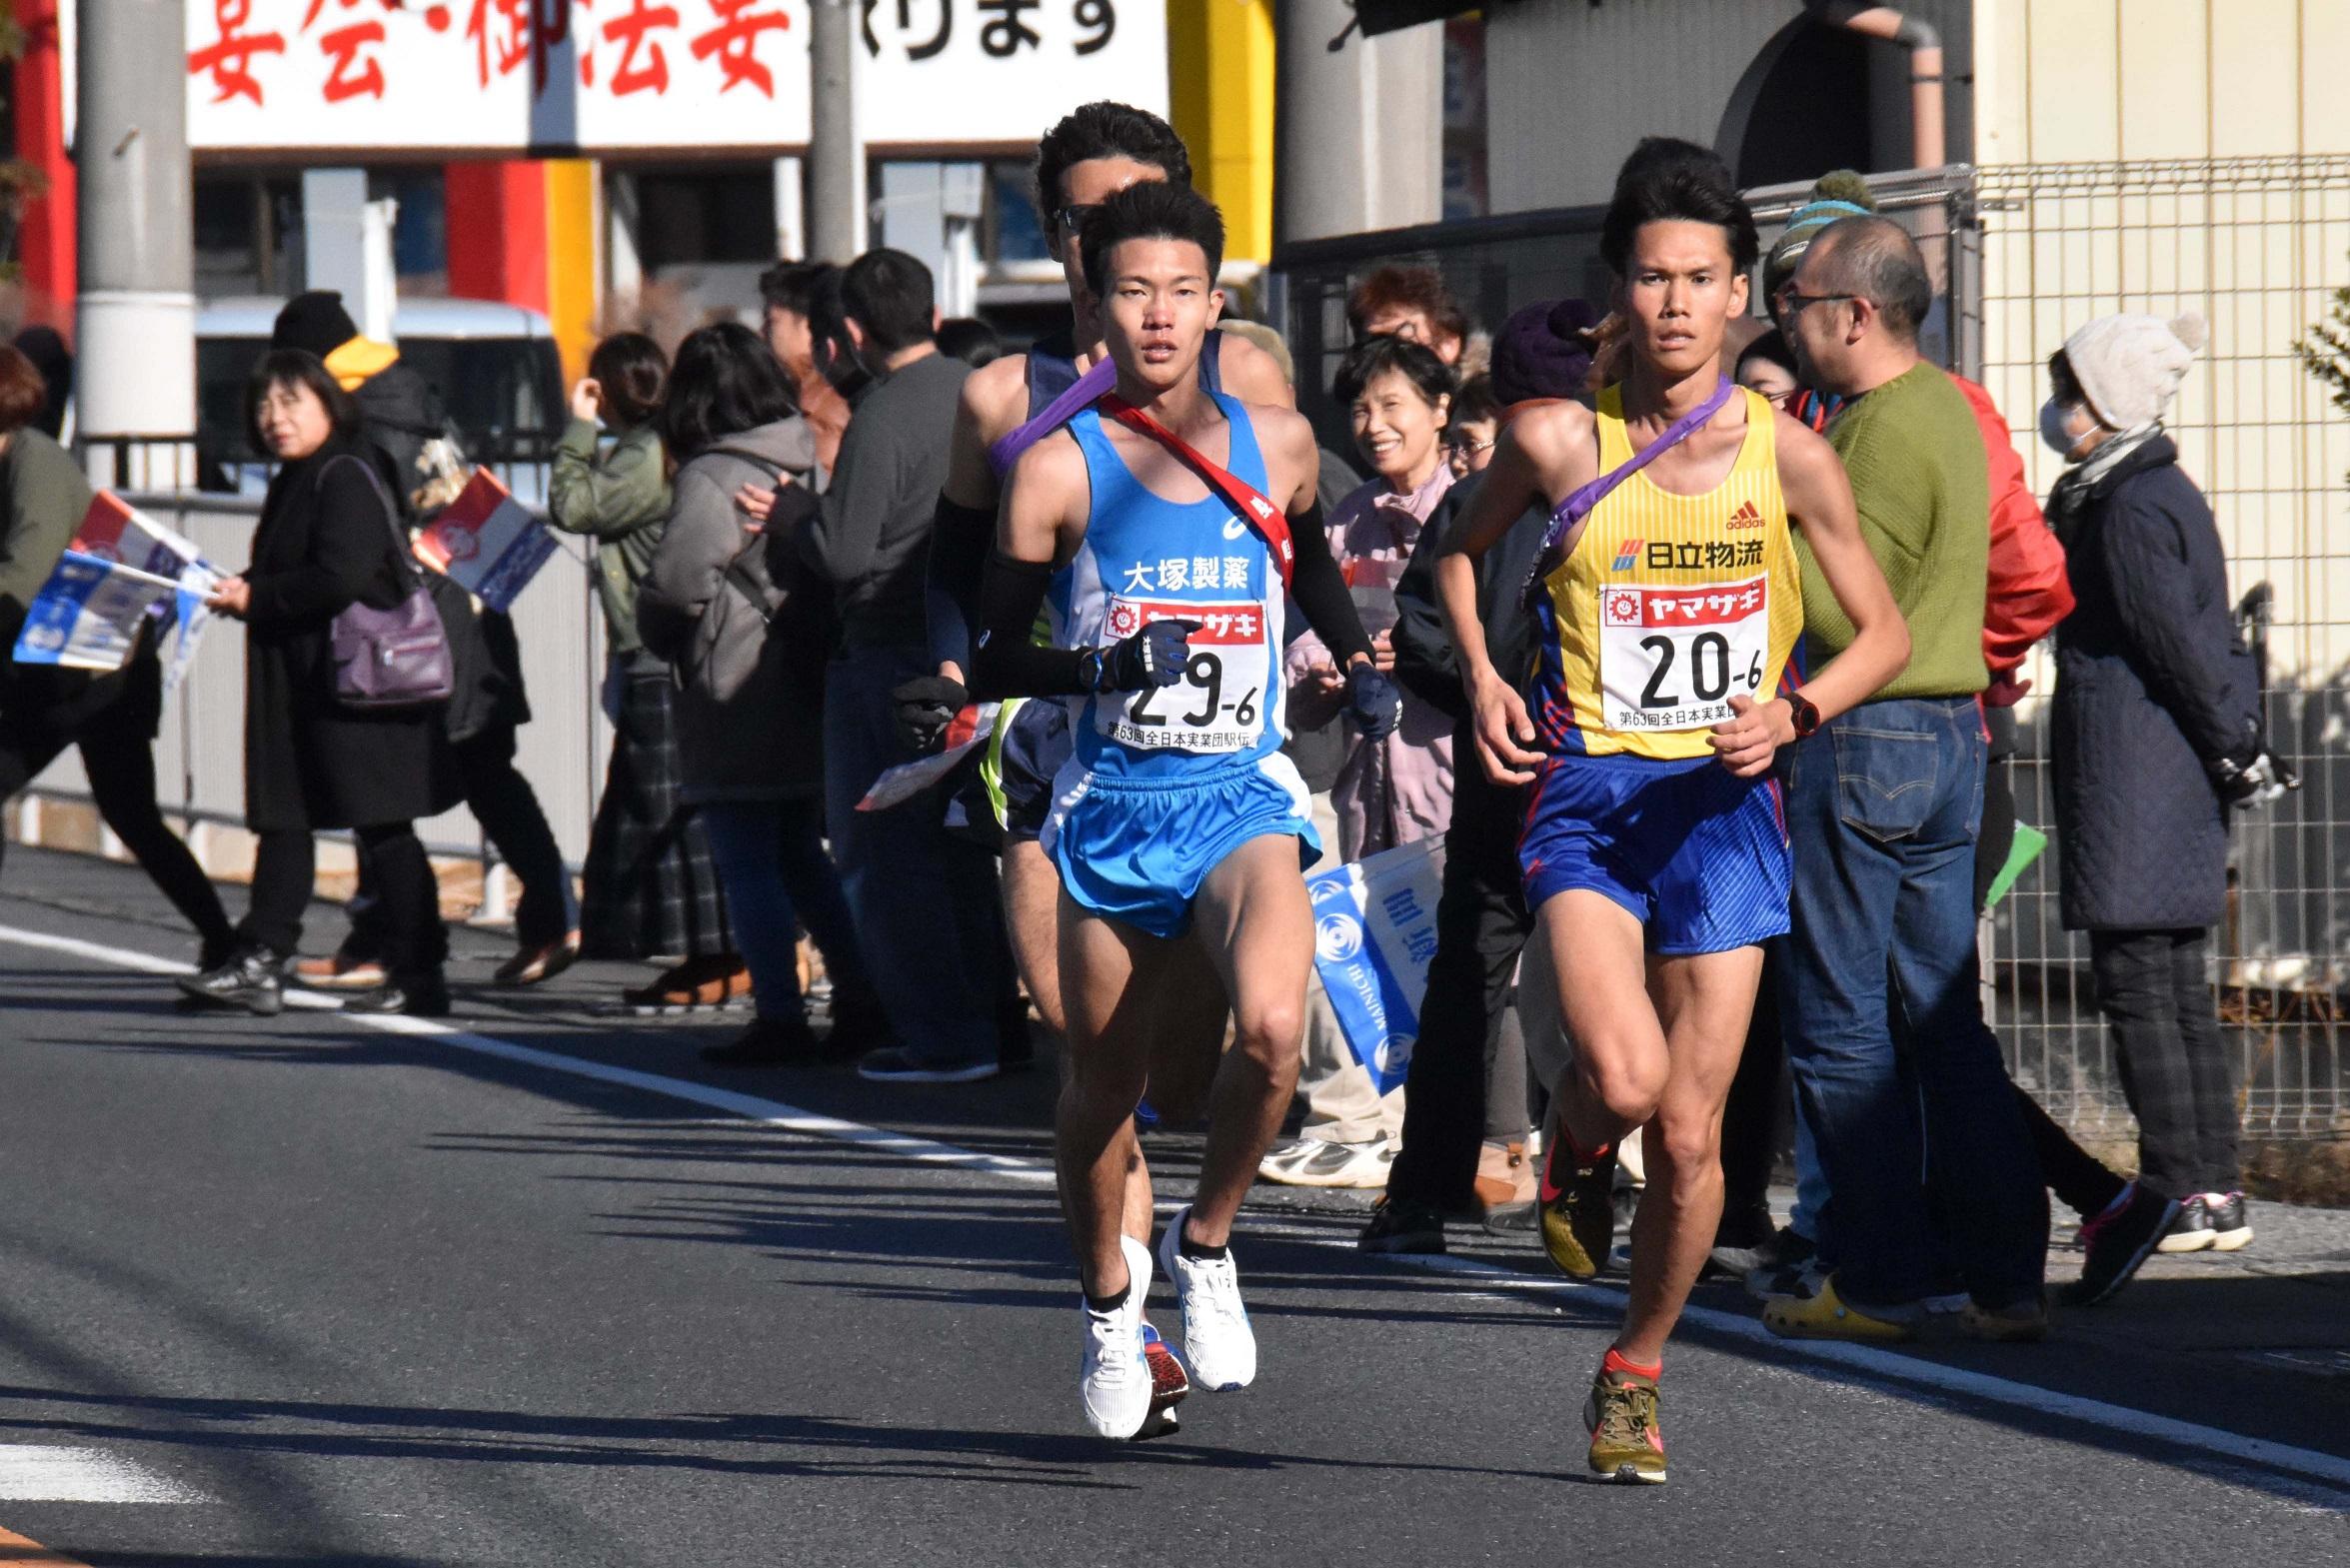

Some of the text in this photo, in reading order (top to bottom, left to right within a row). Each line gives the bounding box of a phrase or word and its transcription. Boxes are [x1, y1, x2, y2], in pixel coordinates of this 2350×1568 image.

[862, 0, 1118, 62] ります
[1726, 519, 1766, 531] adidas
[1125, 557, 1248, 592] 大塚製薬
[1648, 540, 1764, 570] 日立物流
[1649, 590, 1759, 621] ヤマザキ
[1640, 632, 1762, 708] 20-6
[1383, 887, 1438, 981] 新聞
[1346, 963, 1387, 1030] MAINICHI
